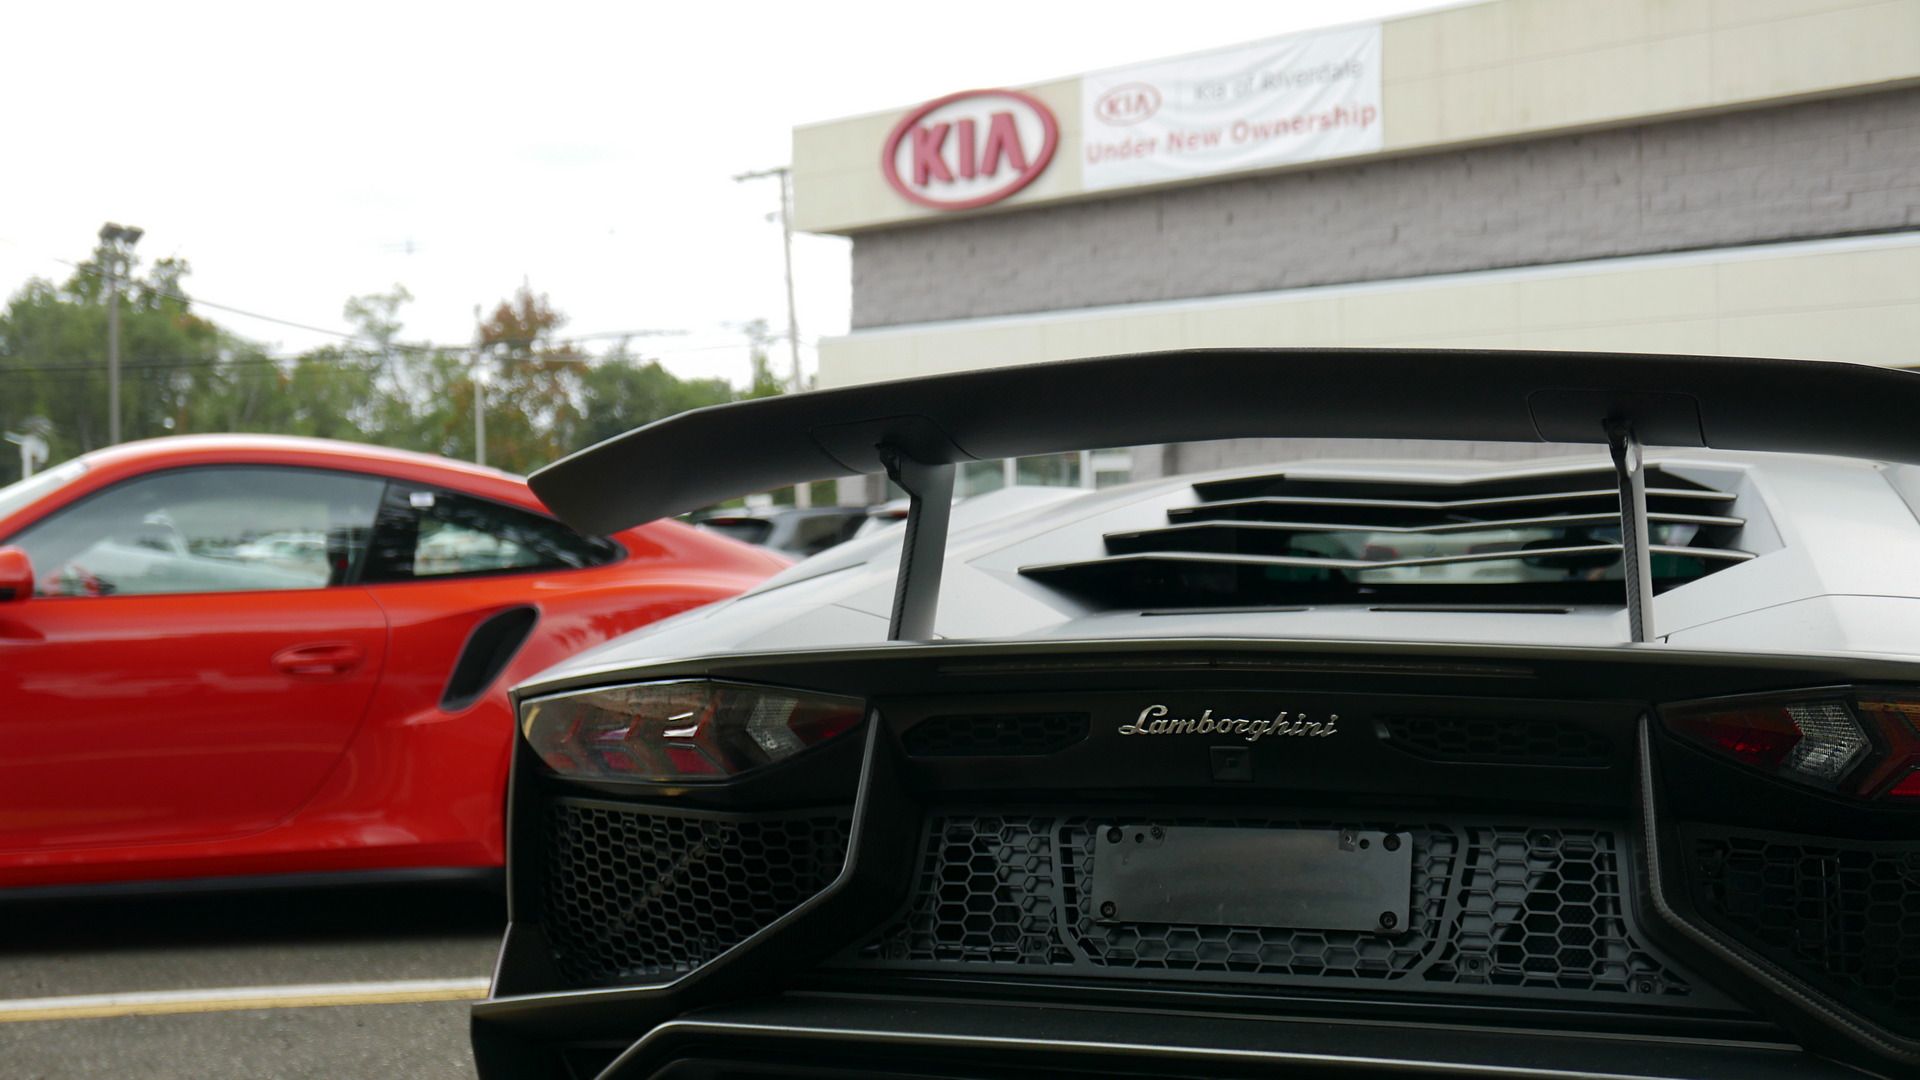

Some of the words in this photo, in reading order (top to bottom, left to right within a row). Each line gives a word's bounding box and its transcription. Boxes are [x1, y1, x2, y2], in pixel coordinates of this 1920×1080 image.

[1105, 93, 1150, 116] KIA
[1194, 81, 1227, 101] Kia
[1236, 74, 1256, 97] of
[912, 112, 1027, 186] KIA
[1086, 136, 1159, 165] Under
[1167, 127, 1222, 152] New
[1230, 103, 1377, 143] Ownership
[1118, 704, 1339, 741] Lamborghini
